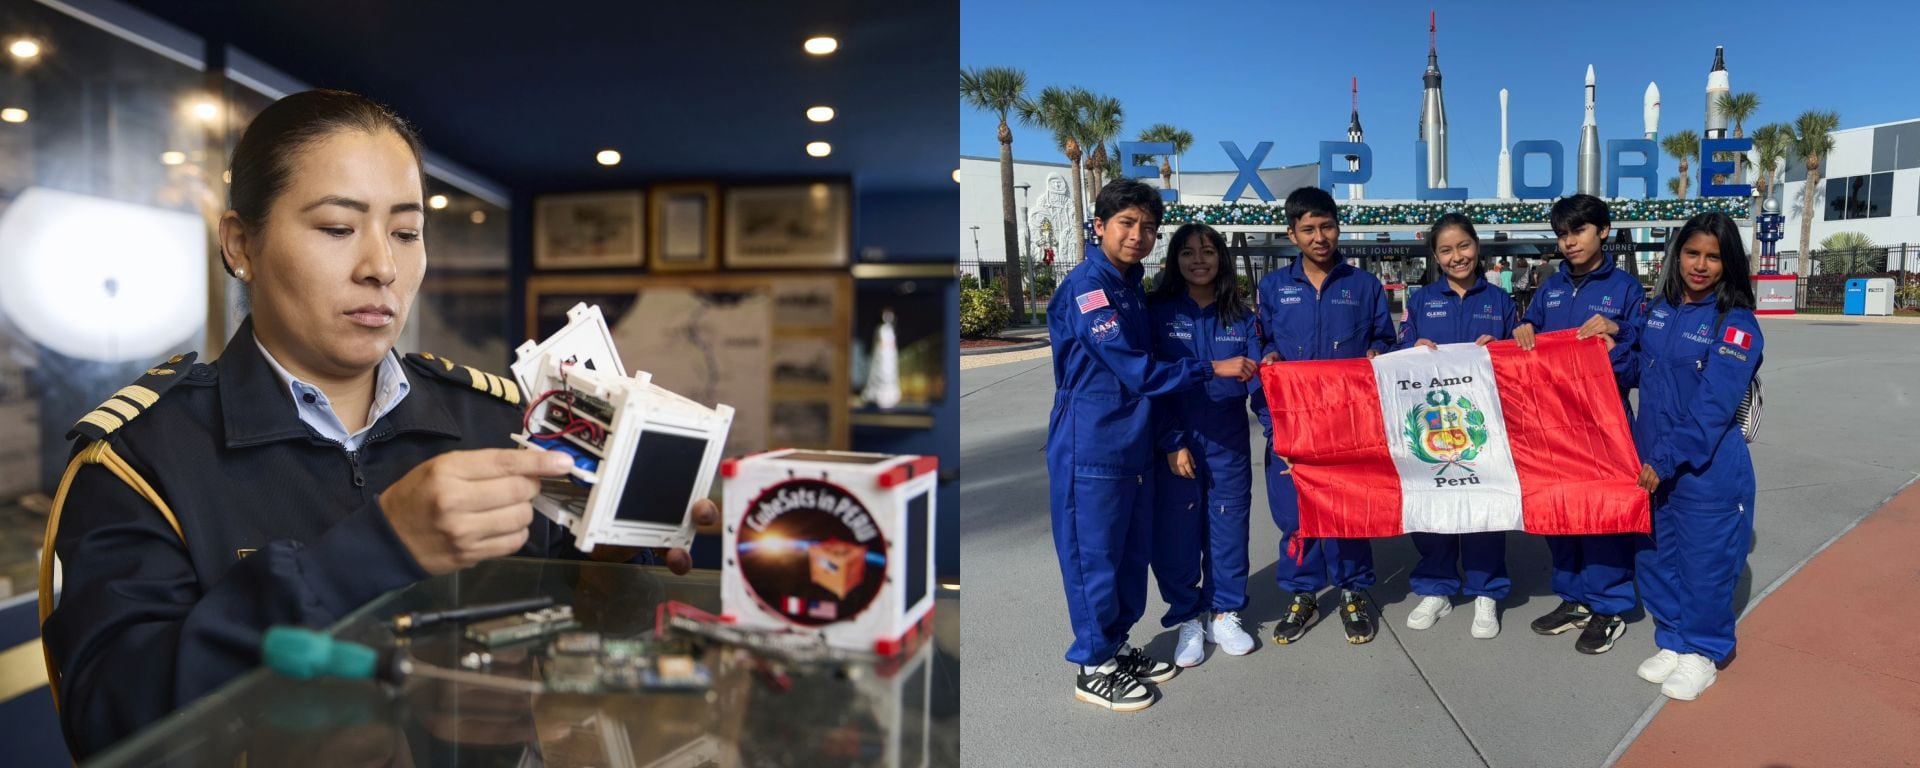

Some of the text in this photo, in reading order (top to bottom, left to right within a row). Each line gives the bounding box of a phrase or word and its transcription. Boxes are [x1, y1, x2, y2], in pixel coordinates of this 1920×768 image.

[1119, 138, 1753, 201] EXPLORE
[1351, 247, 1367, 255] THE
[1371, 247, 1410, 255] JOURNEY
[1602, 243, 1637, 252] OURNEY
[1091, 320, 1118, 334] NASA
[1397, 375, 1473, 390] Te Amo
[1434, 473, 1481, 487] Perú
[746, 487, 817, 533] CubeSats
[818, 488, 837, 514] in
